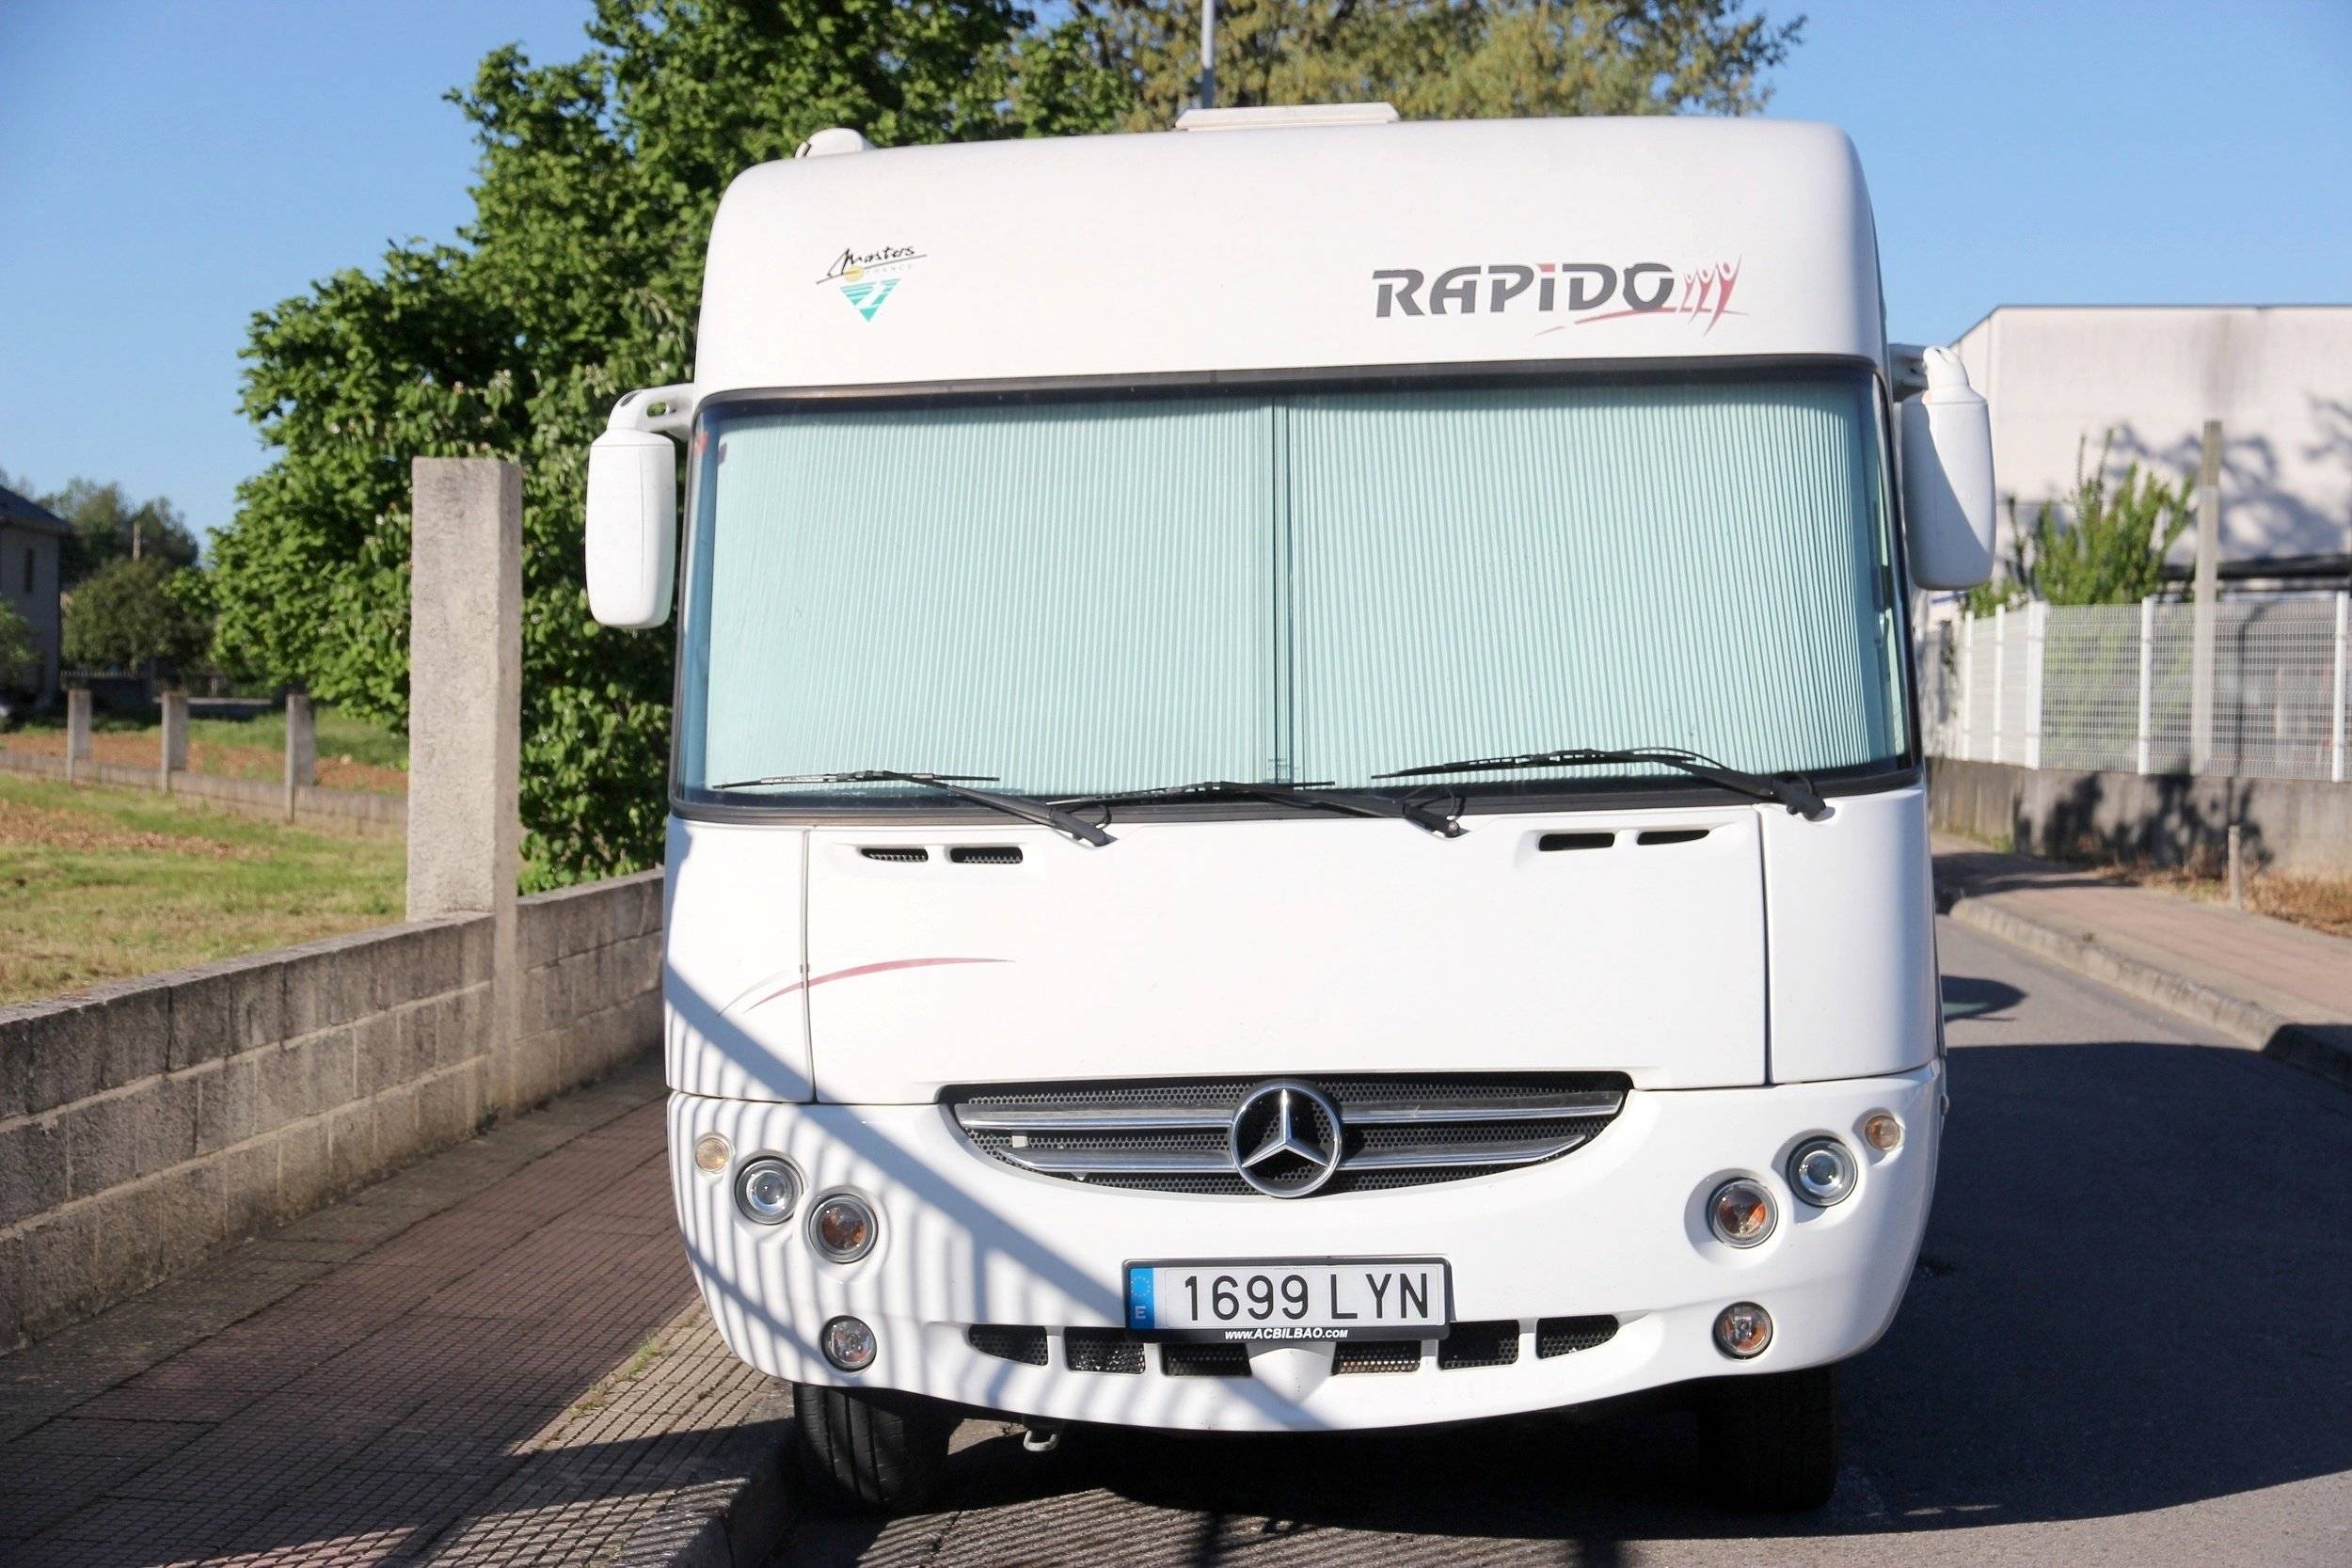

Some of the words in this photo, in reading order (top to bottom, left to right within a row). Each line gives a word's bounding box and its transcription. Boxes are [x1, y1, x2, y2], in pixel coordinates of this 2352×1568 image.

[827, 245, 915, 278] Masters
[1135, 1305, 1147, 1319] E
[1184, 1275, 1309, 1322] 1699
[1329, 1273, 1428, 1320] LYN
